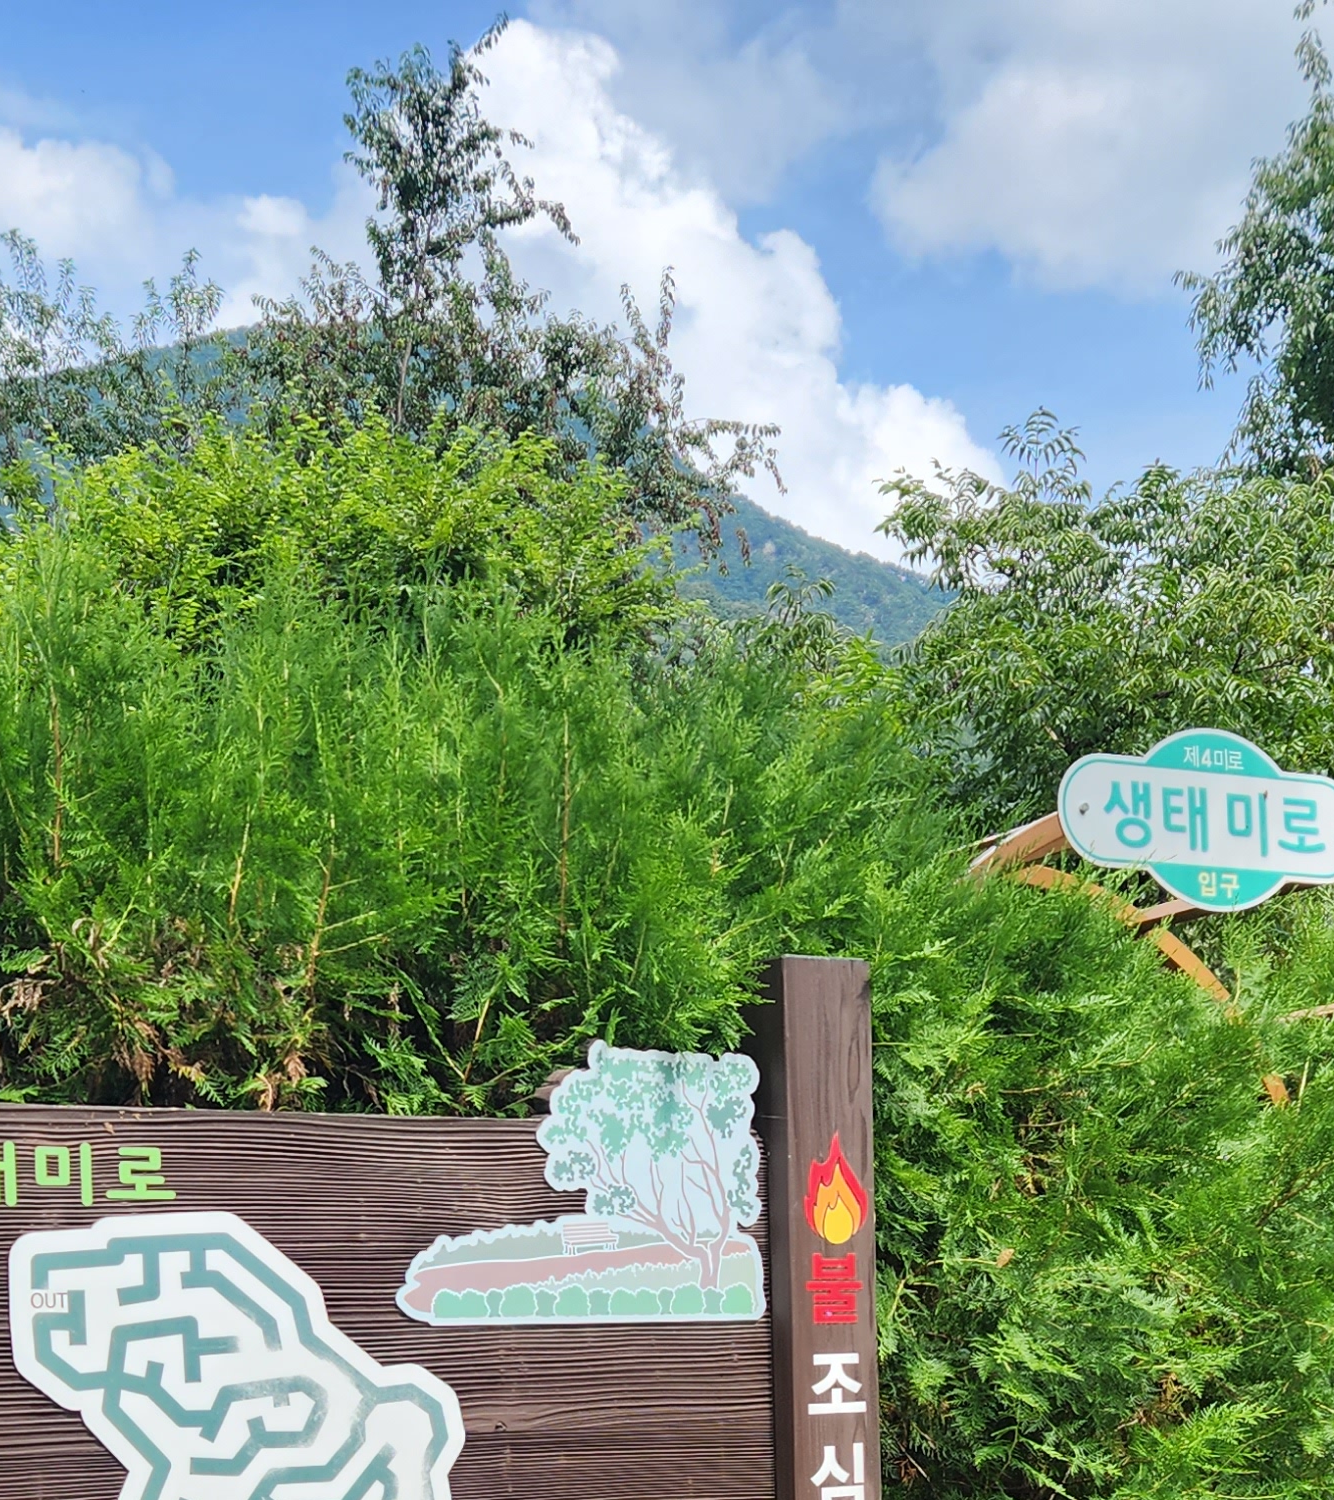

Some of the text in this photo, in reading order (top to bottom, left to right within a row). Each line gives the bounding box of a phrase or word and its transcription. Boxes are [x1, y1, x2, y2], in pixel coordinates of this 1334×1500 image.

[1183, 745, 1244, 770] 제4미로
[1103, 780, 1326, 857] 생태미로
[1197, 871, 1240, 897] 입구
[30, 1293, 68, 1309] OUT
